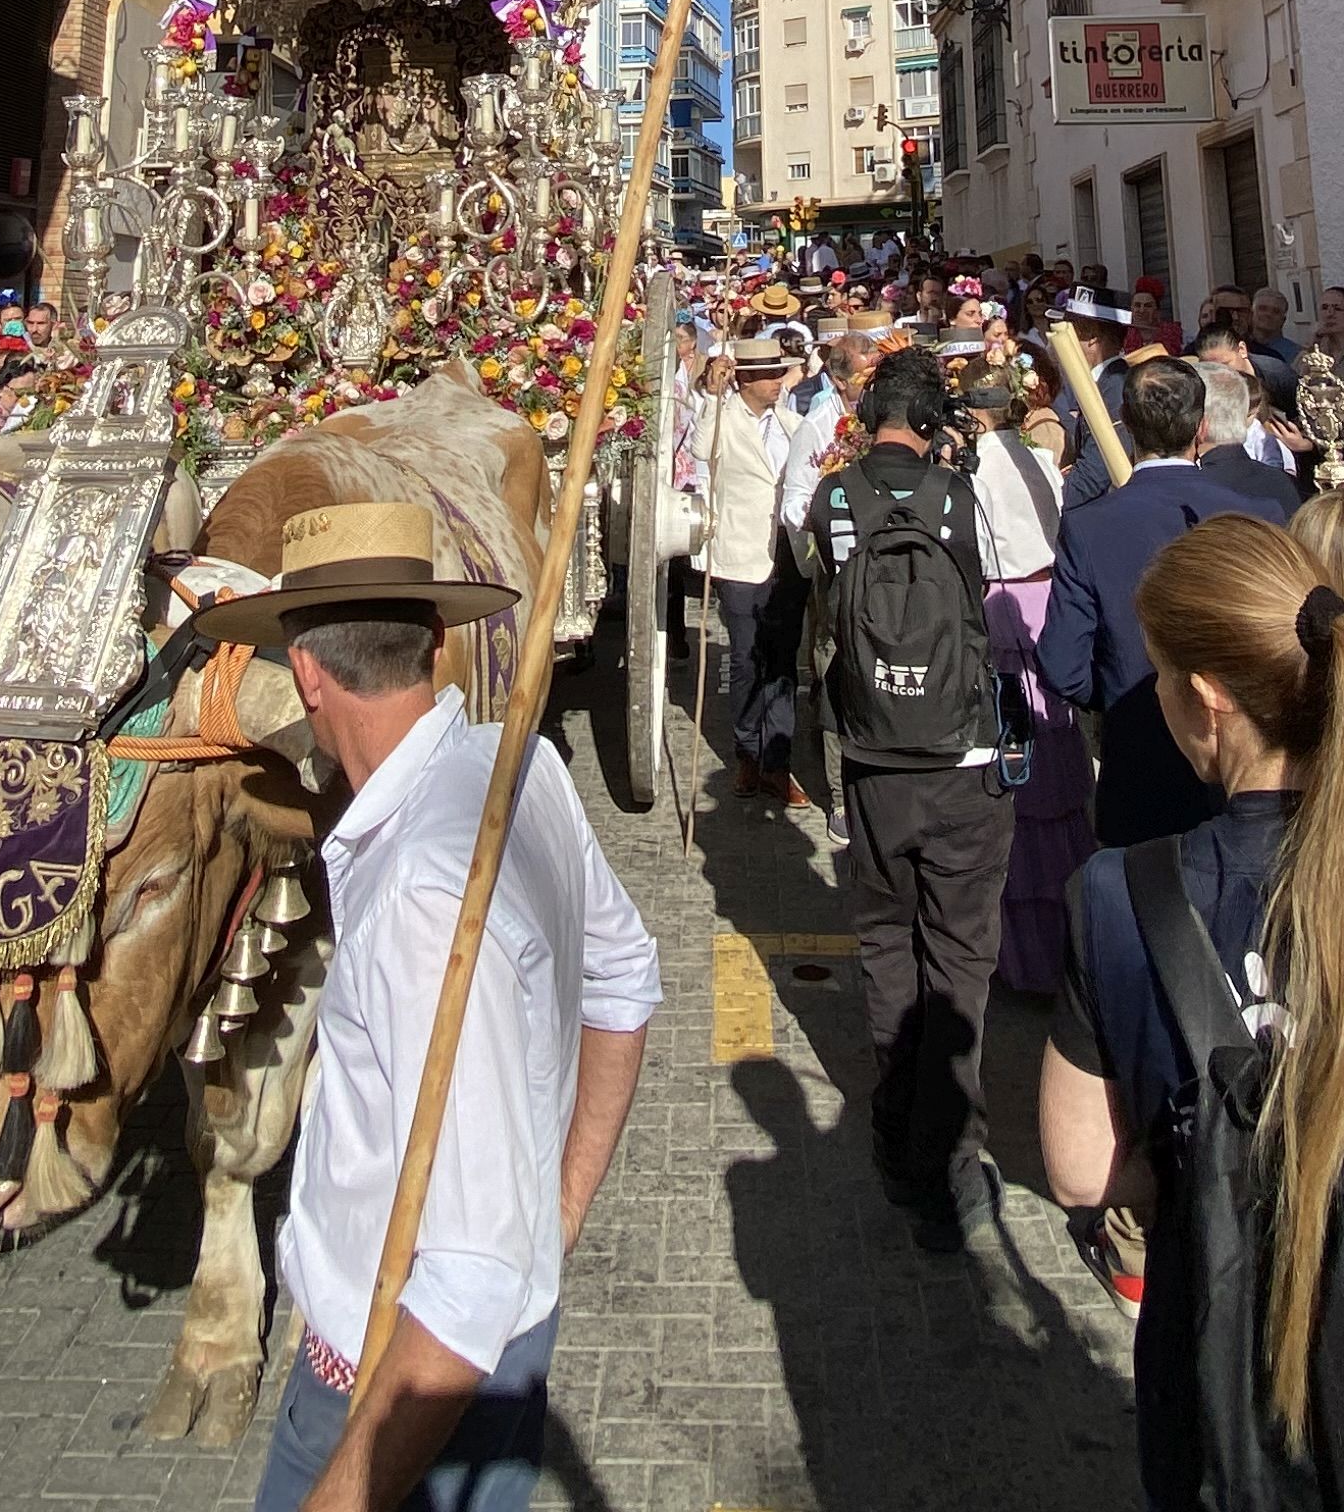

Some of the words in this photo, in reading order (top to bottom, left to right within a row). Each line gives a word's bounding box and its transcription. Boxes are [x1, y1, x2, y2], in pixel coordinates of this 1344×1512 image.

[1094, 83, 1159, 99] GUERRERO
[1070, 106, 1109, 115] Limpieza
[1123, 106, 1144, 114] seco
[1145, 105, 1187, 113] artesanal
[875, 657, 929, 687] PTV
[874, 678, 926, 697] TELECOM
